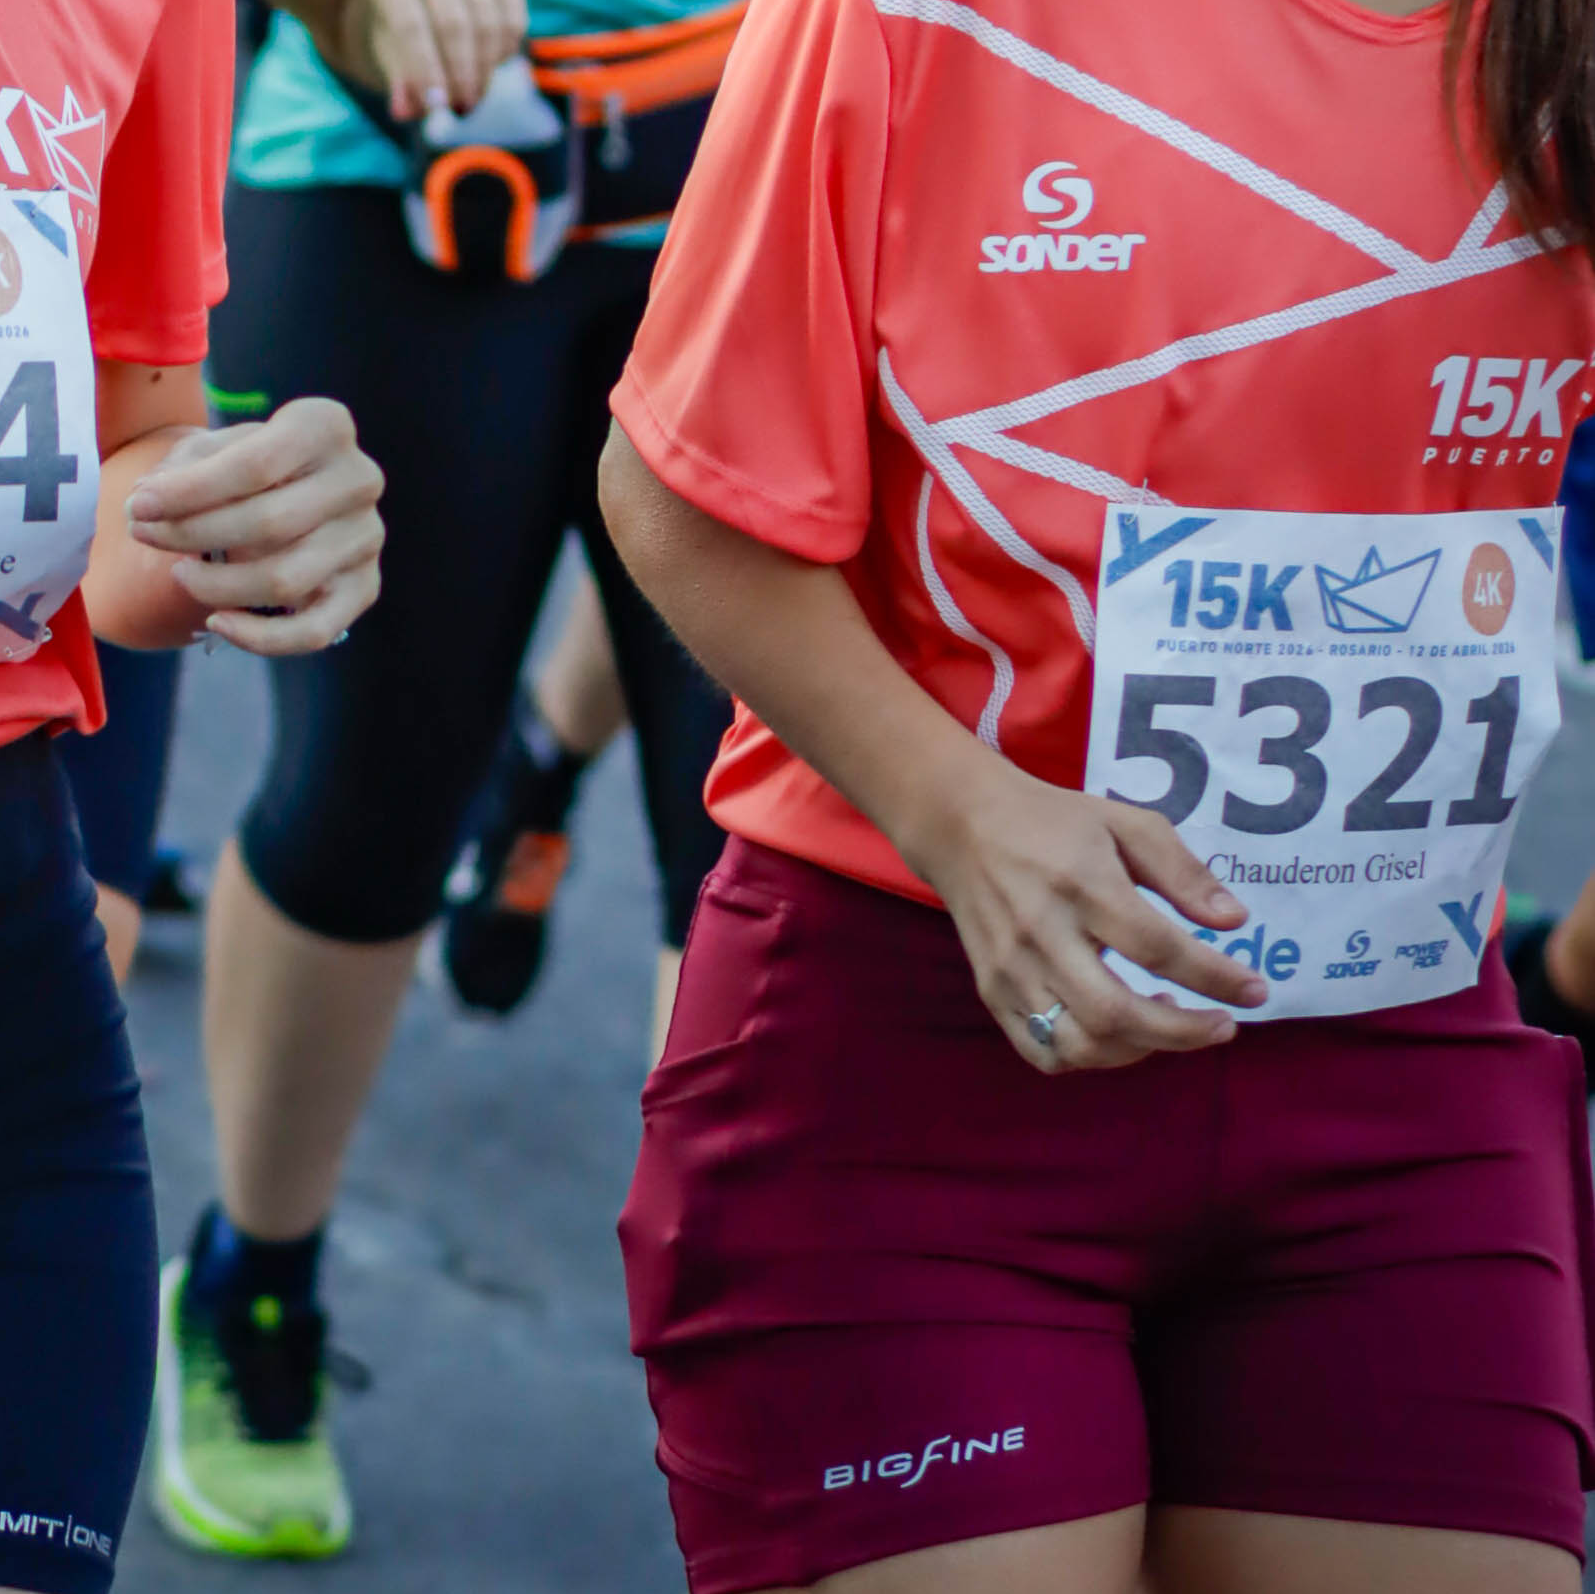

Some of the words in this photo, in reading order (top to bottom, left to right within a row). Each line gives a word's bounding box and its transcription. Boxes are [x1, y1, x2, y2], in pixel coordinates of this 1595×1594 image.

[1430, 355, 1587, 439] 15K
[1422, 446, 1555, 466] PUERTO
[1162, 558, 1304, 632] 15K
[1472, 569, 1504, 609] 4K
[1156, 638, 1217, 654] PUERTO
[1223, 641, 1273, 655] NORTE
[1278, 642, 1314, 656] 2026
[1329, 643, 1392, 657] ROSARIO
[1409, 644, 1425, 658] 12
[1430, 644, 1447, 657] DE
[1452, 643, 1487, 656] ABRIL
[1106, 673, 1521, 836] 5321
[1205, 853, 1356, 885] Chauderon
[1364, 850, 1427, 884] Gisel
[1394, 939, 1449, 959] POWER
